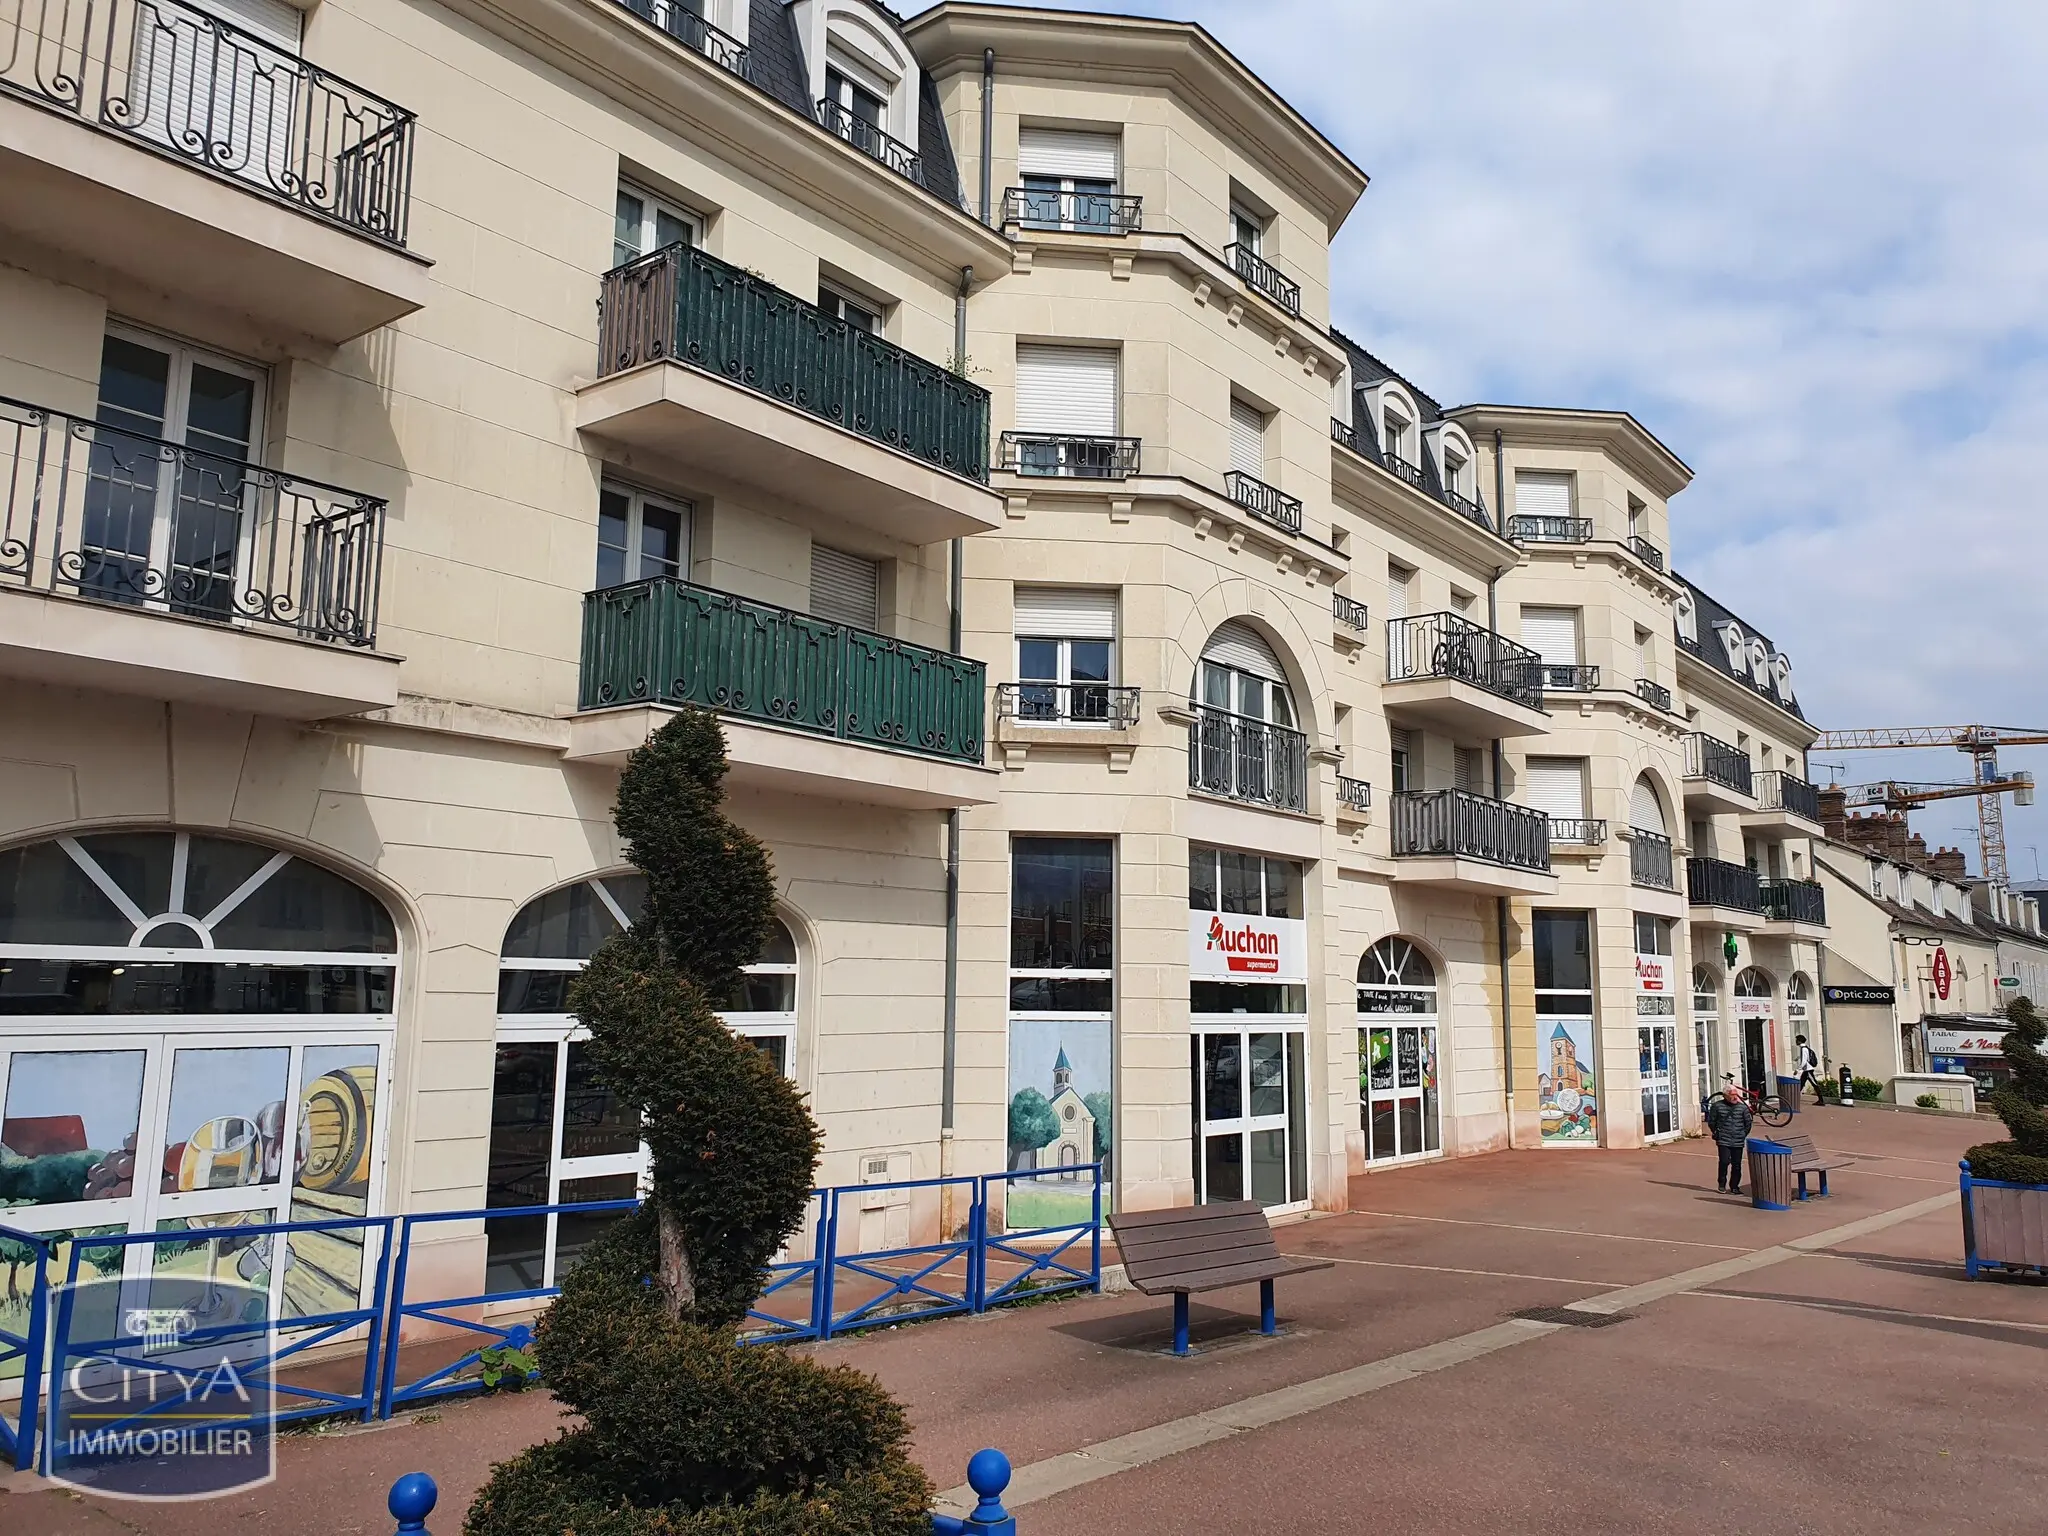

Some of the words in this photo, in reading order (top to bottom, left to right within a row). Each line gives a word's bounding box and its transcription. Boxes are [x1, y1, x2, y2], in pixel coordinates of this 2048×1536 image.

[1867, 788, 1883, 796] EC-B
[1206, 915, 1279, 955] Auchan
[1635, 955, 1663, 978] Auchan
[1937, 953, 1946, 994] TABAC
[1834, 989, 1863, 1001] Optic
[1863, 990, 1890, 999] 2000
[1959, 1038, 1974, 1050] Le
